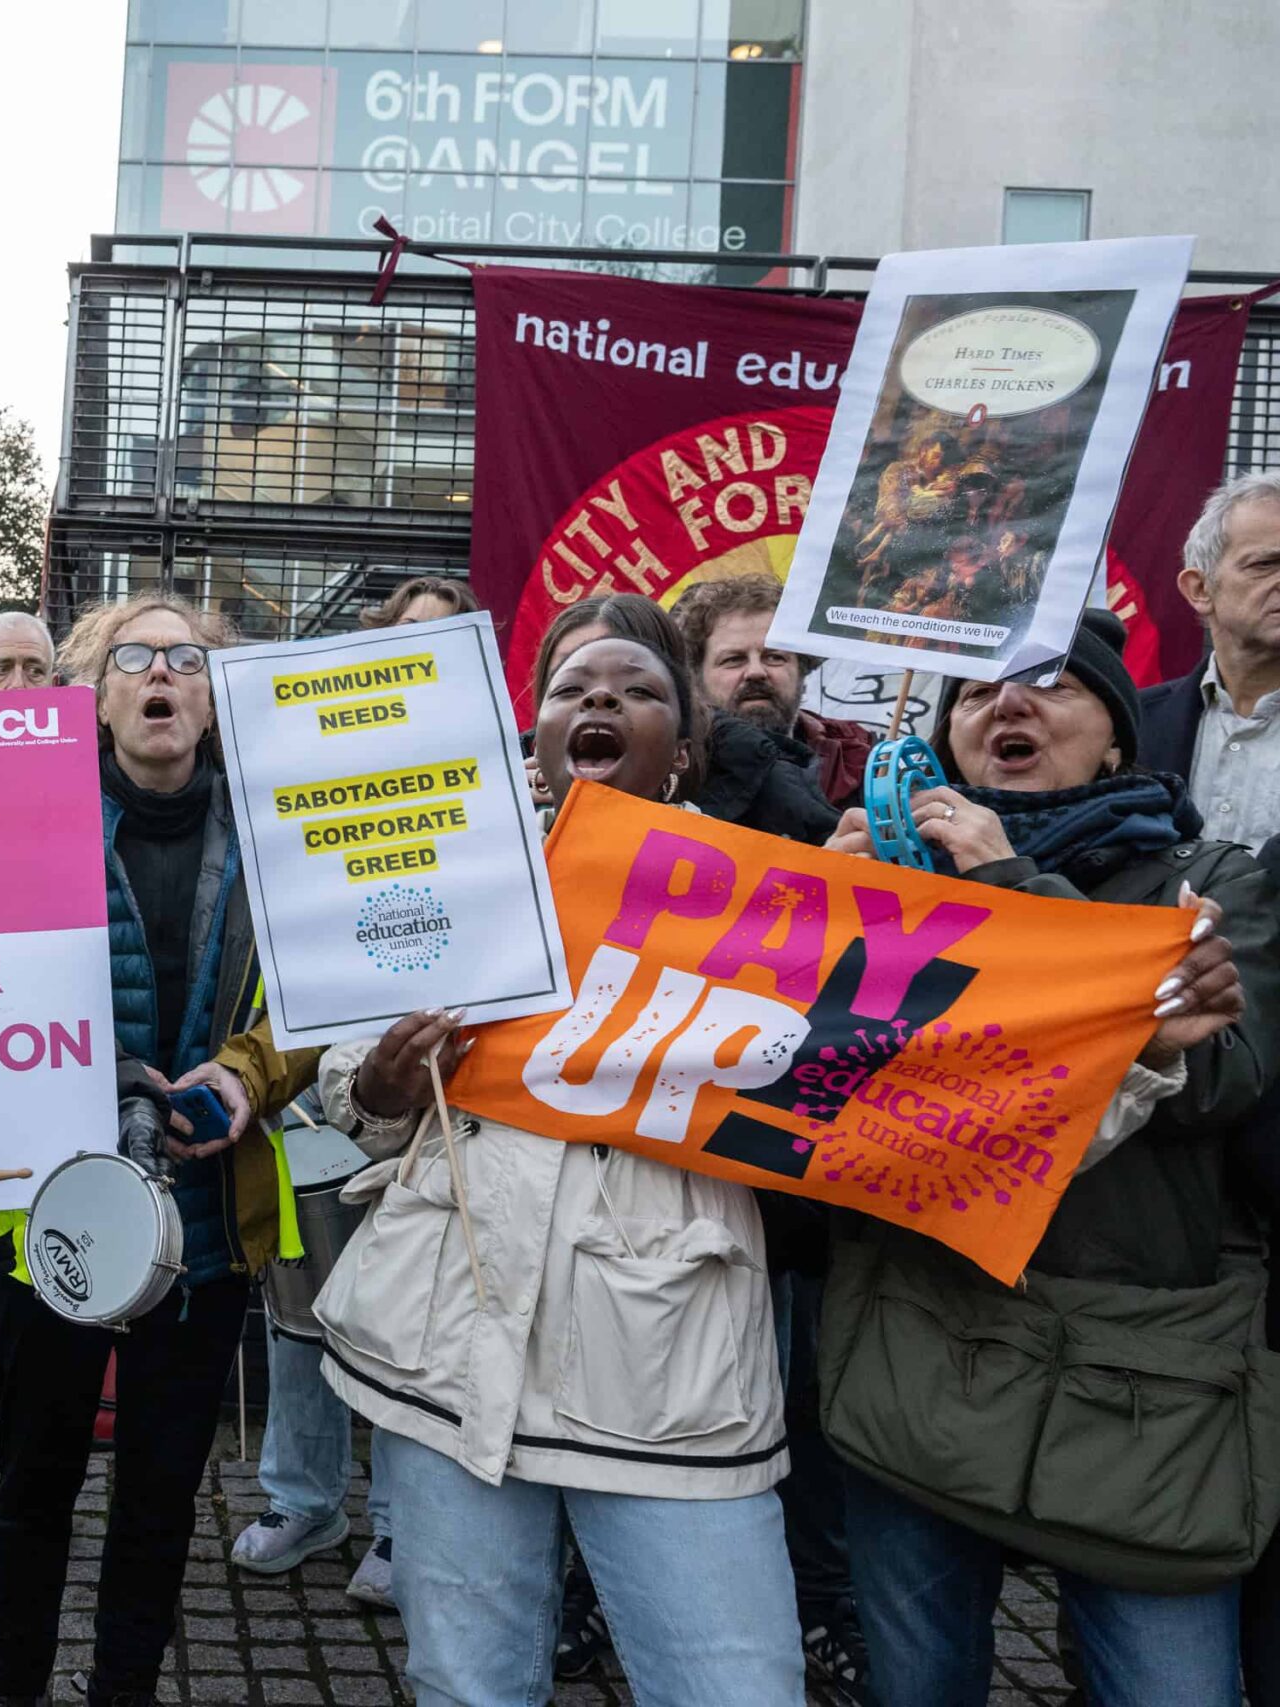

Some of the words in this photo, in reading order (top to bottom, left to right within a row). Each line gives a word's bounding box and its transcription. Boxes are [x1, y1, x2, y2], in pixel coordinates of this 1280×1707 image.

[365, 70, 461, 122] 6th
[474, 72, 669, 129] FORM
[361, 135, 674, 196] @ANGEL
[505, 211, 582, 250] City
[595, 213, 747, 251] College
[515, 312, 709, 379] national
[736, 351, 844, 391] edu
[924, 376, 986, 391] CHARLES
[991, 378, 1055, 392] DICKENS
[542, 479, 639, 604] CITY
[660, 421, 787, 503] AND
[829, 608, 848, 622] We
[849, 613, 879, 627] teach
[882, 616, 899, 628] the
[901, 619, 962, 636] conditions
[963, 626, 981, 637] we
[983, 627, 1005, 640] live
[274, 660, 436, 701] COMMUNITY
[318, 701, 408, 731] NEEDS
[276, 773, 435, 814] SABOTAGED
[443, 766, 479, 789] BY
[304, 807, 468, 849] CORPORATE
[346, 847, 437, 878] GREED
[356, 914, 453, 944] education
[378, 905, 425, 922] national
[604, 829, 992, 1021] PAY
[389, 936, 423, 950] union
[885, 1059, 1016, 1116] national
[792, 1062, 1054, 1185] education
[857, 1116, 948, 1170] union
[46, 1244, 86, 1289] RMV
